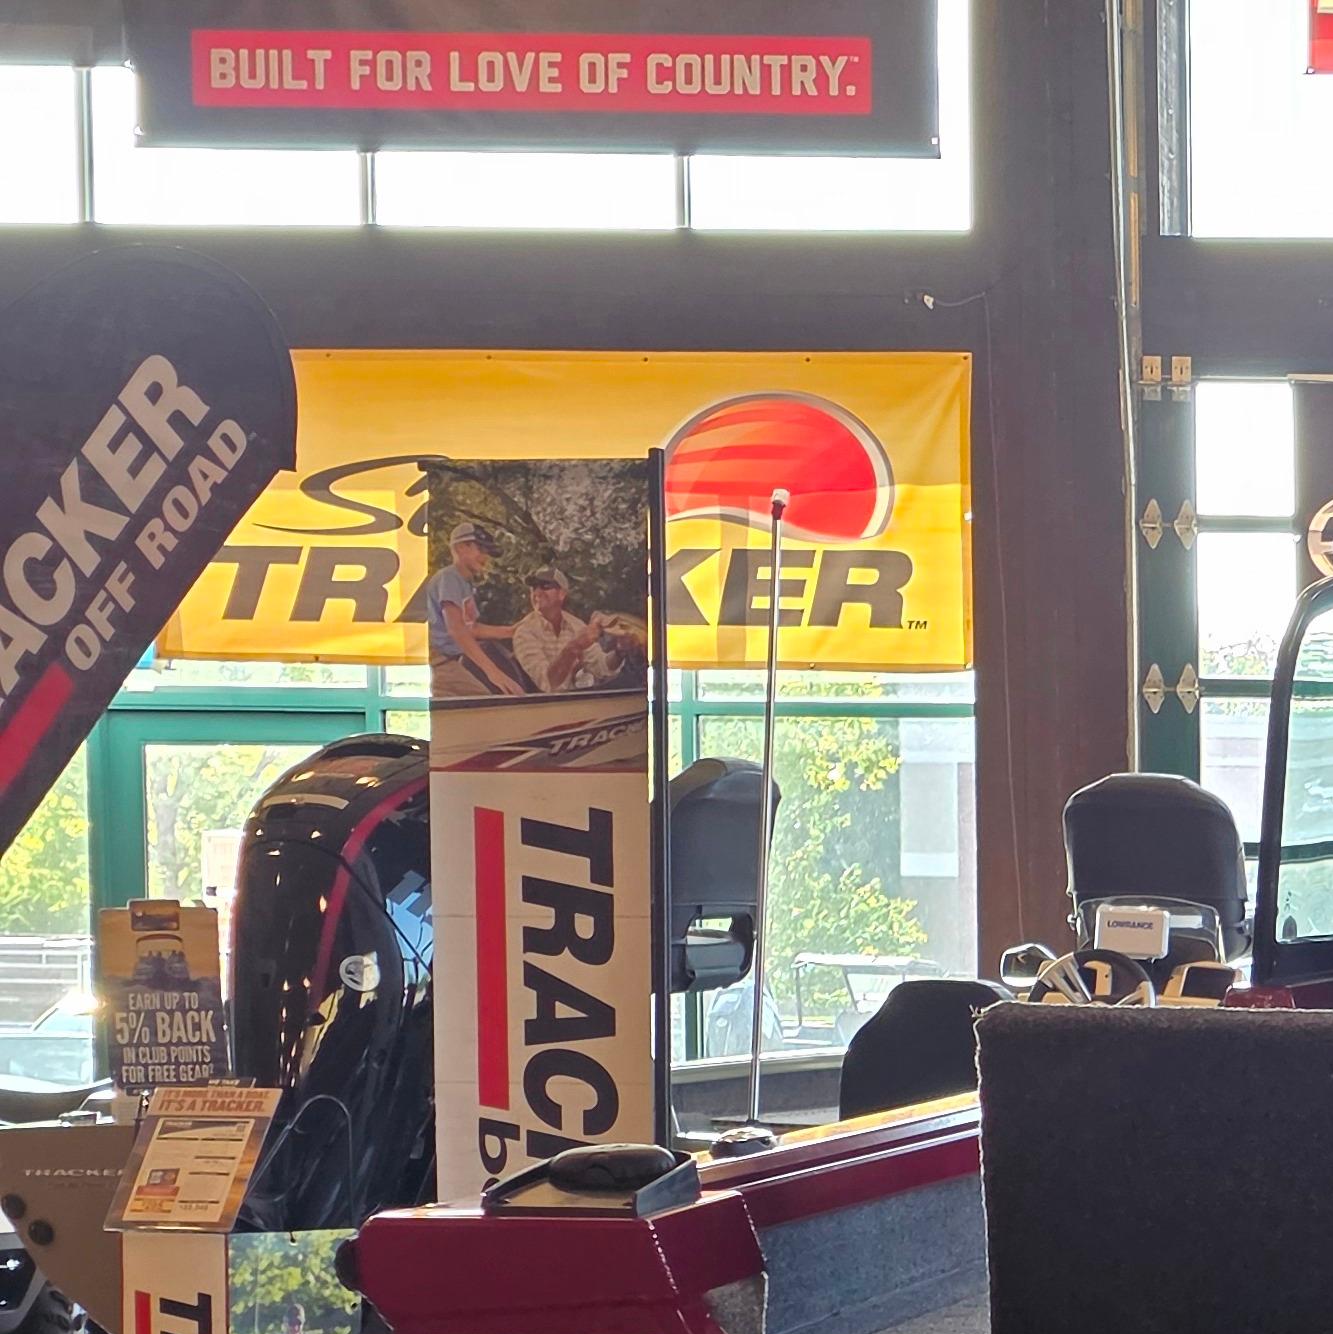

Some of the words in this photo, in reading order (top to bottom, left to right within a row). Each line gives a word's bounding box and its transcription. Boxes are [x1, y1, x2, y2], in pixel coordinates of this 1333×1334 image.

[210, 49, 333, 91] BUILT
[350, 50, 432, 92] FOR
[449, 52, 563, 94] LOVE
[579, 53, 632, 95] OF
[65, 561, 135, 671] OFF
[134, 419, 248, 571] ROAD
[128, 993, 160, 1010] EARN
[163, 992, 180, 1009] UP
[183, 991, 198, 1009] TO
[115, 1011, 150, 1045] 5%
[155, 1010, 216, 1043] BACK
[123, 1046, 136, 1063] IN
[138, 1046, 167, 1063] CLUB
[170, 1045, 211, 1063] POINTS
[122, 1066, 144, 1083] FOR
[148, 1065, 176, 1082] FREE
[158, 1099, 186, 1111] IT'S
[187, 1099, 198, 1111] A
